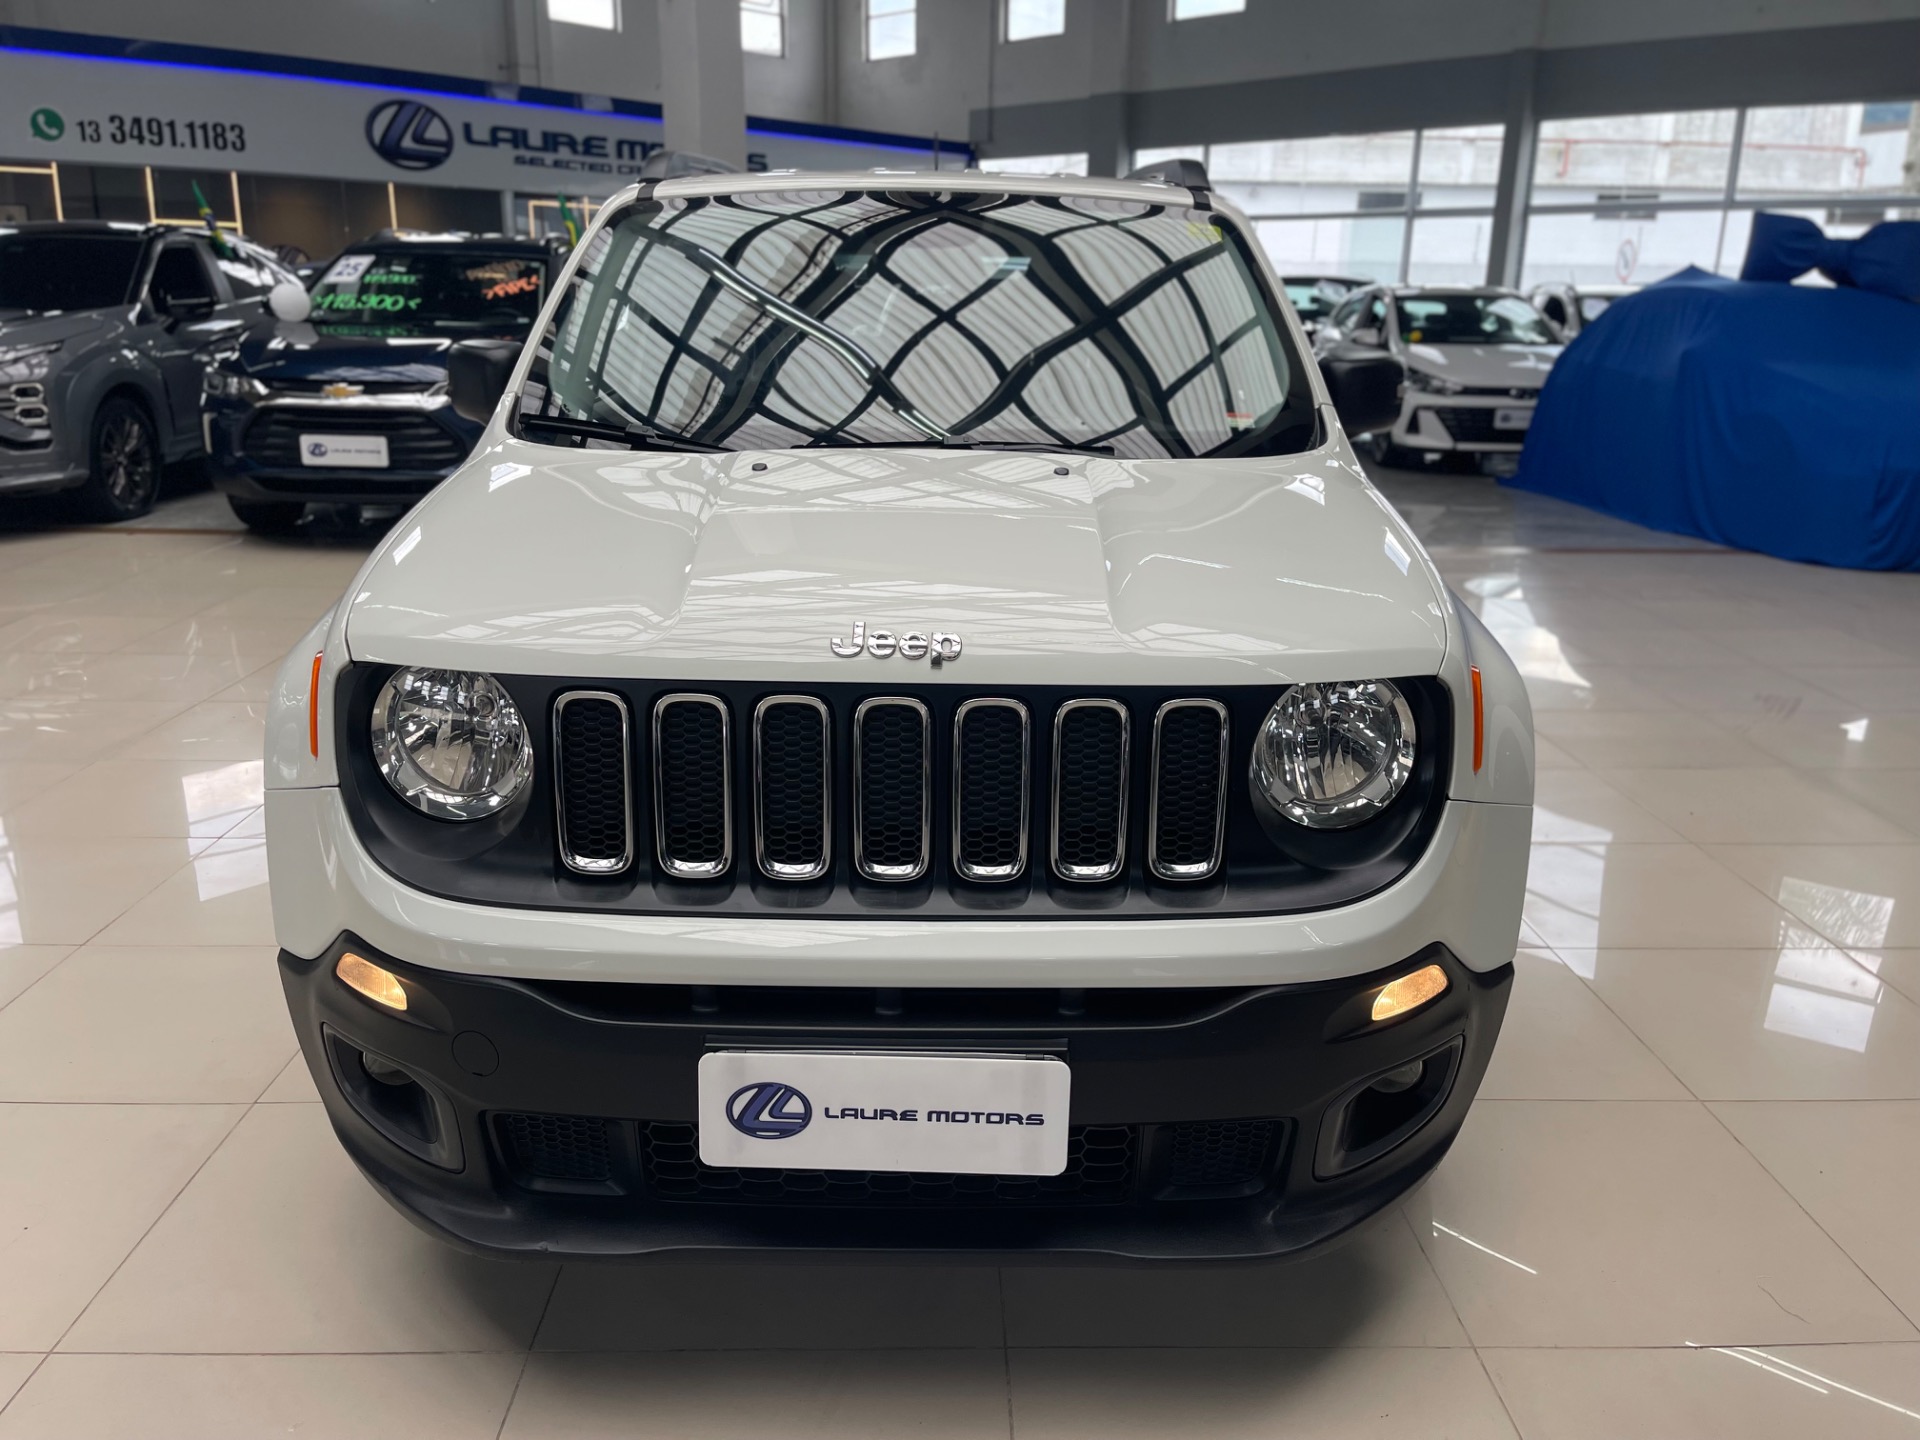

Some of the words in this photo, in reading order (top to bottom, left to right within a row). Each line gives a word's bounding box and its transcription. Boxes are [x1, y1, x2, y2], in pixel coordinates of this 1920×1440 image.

[76, 119, 102, 143] 13
[108, 114, 246, 152] 3491.1183
[463, 122, 607, 158] LAURE
[514, 155, 613, 175] SELECTED
[830, 621, 962, 669] Jeep
[824, 1107, 918, 1122] LAURE
[926, 1110, 1045, 1126] MOTORS
